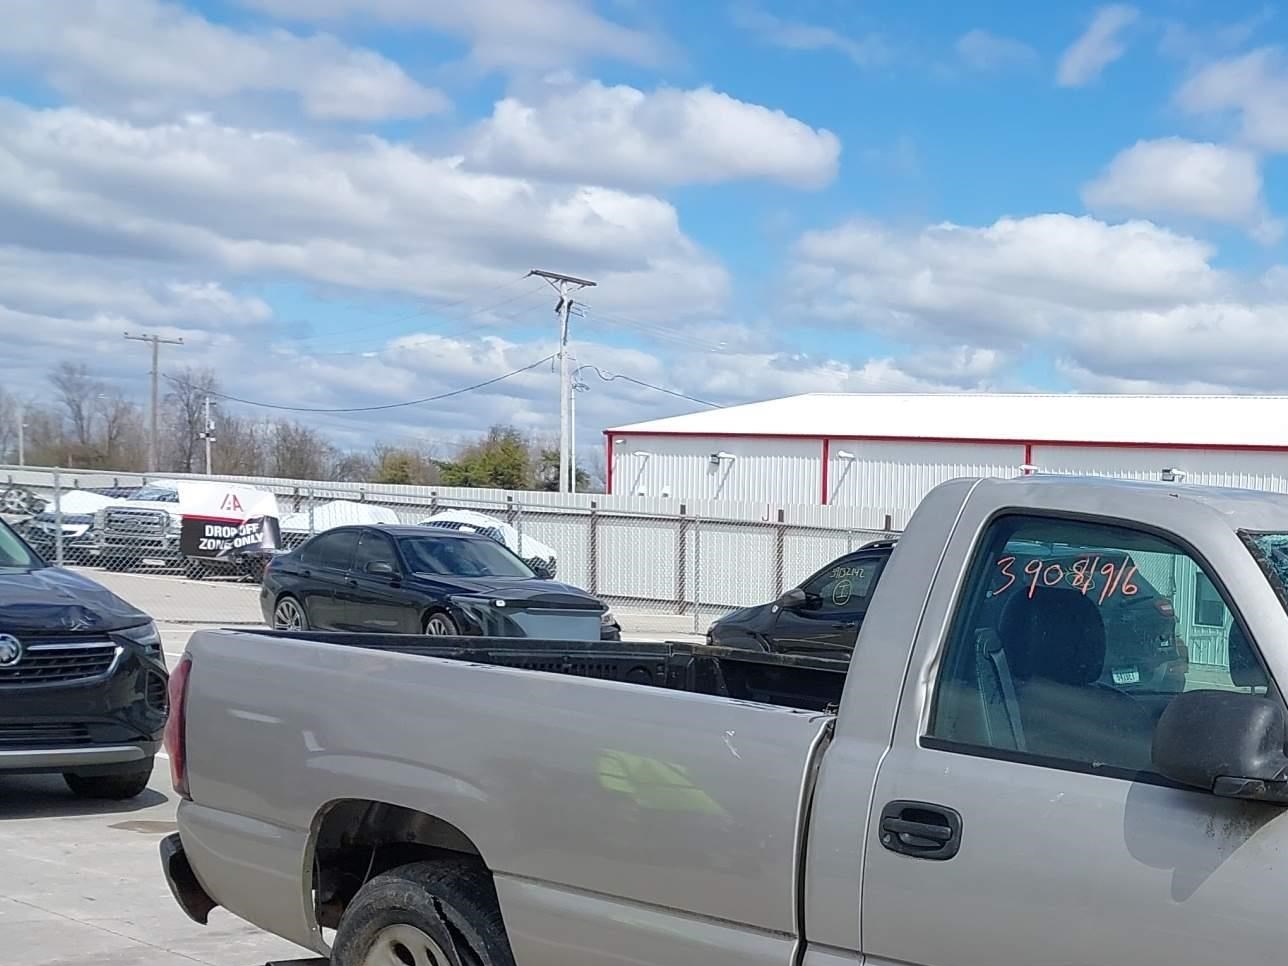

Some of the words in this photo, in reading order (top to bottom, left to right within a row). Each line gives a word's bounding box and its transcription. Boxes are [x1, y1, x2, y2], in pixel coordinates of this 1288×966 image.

[205, 524, 238, 538] DROP
[239, 523, 260, 536] OFF
[198, 537, 233, 551] ZONE
[233, 532, 265, 549] ONLY
[992, 555, 1139, 606] 39081916
